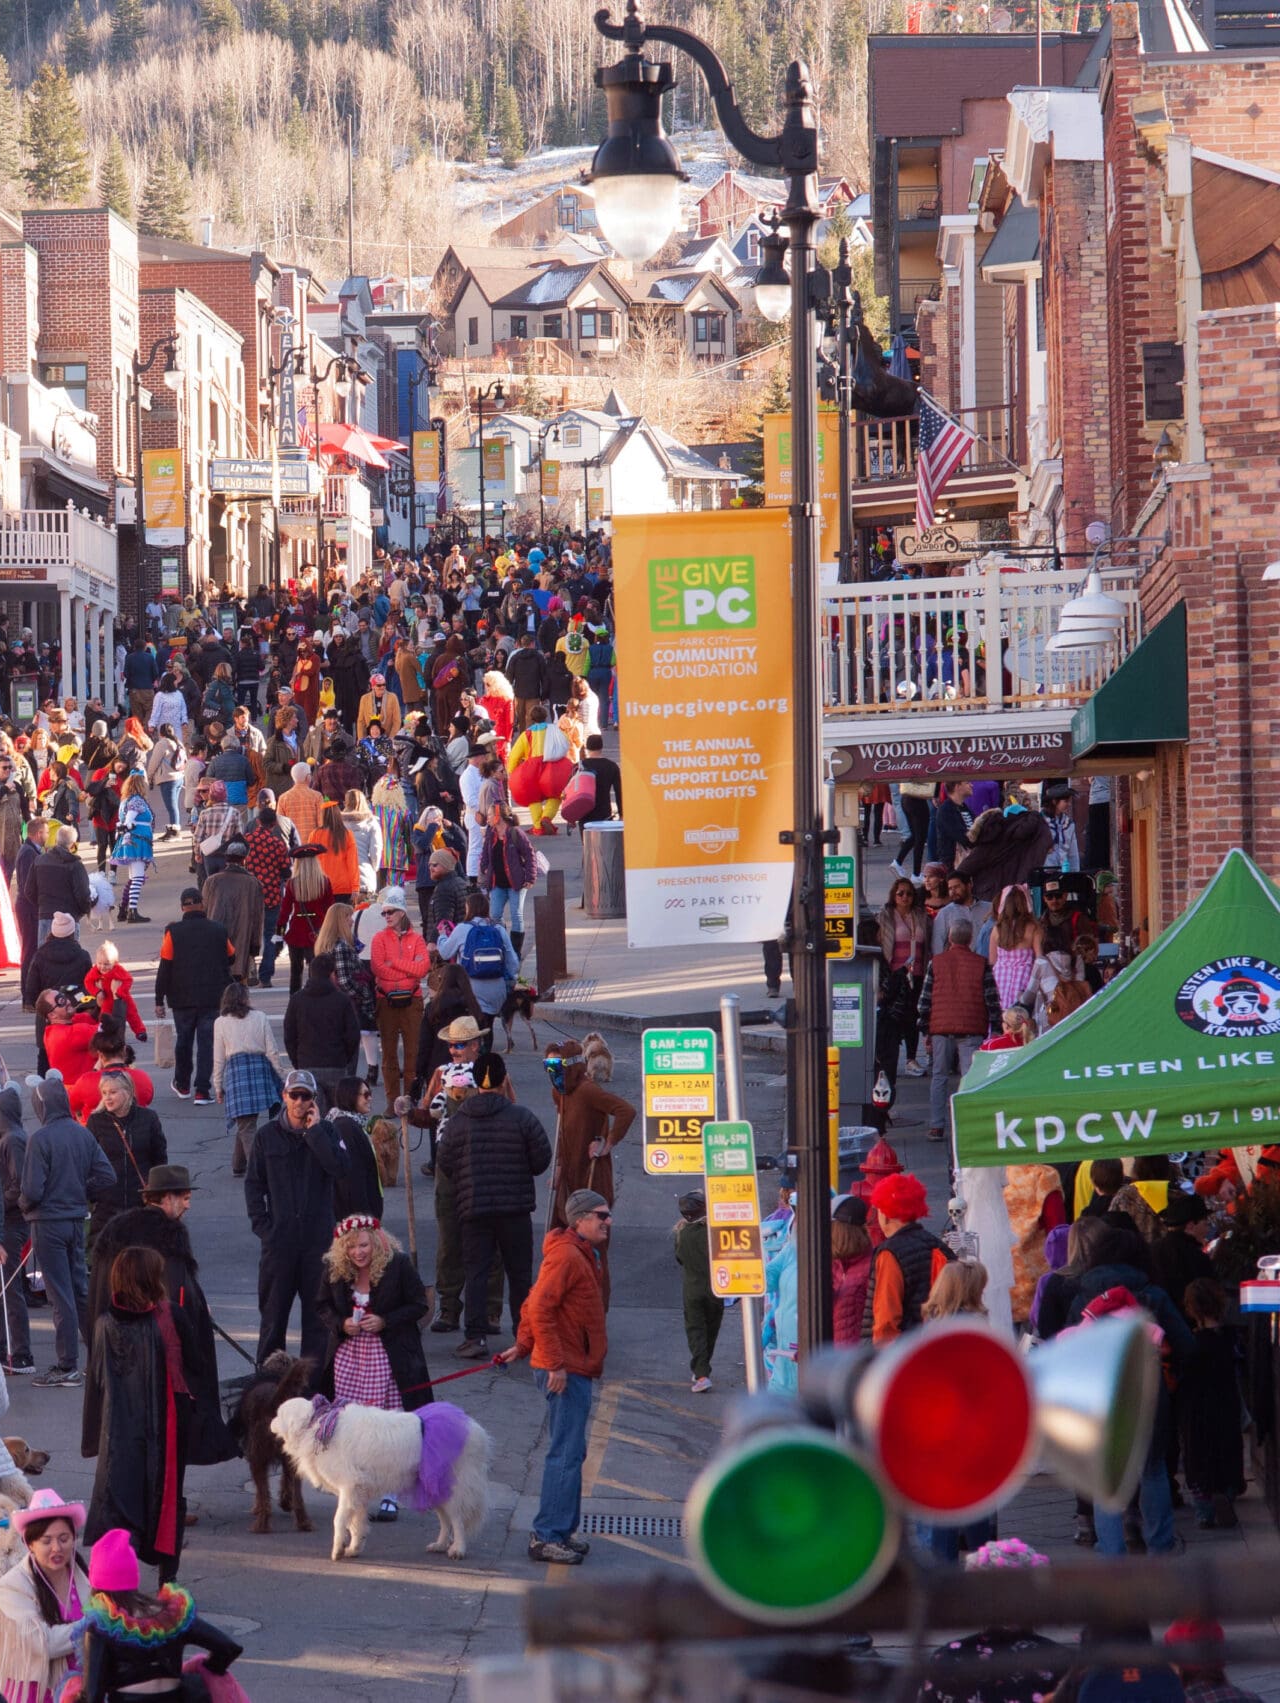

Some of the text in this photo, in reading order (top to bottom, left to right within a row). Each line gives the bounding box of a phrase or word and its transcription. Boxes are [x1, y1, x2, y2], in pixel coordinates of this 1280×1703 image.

[681, 561, 749, 586] GIVE
[655, 563, 680, 627] LIVE
[683, 586, 751, 625] PC
[680, 635, 732, 646] PARK CITY
[652, 646, 758, 664] COMMUNITY
[652, 662, 758, 680] FOUNDATION
[625, 697, 789, 718] livepcgivepc.org
[663, 737, 755, 753] THE ANNUAL
[859, 732, 1063, 760] WOODBURY JEWELERS
[657, 752, 761, 769] GIVING DAY TO
[873, 752, 1045, 774] Custom Jewelry Designs
[650, 769, 768, 786] SUPPORT LOCAL
[663, 785, 757, 801] NONPROFITS
[657, 873, 768, 888] PRESENTING SPONSOR
[691, 895, 763, 908] PARK CITY
[1178, 965, 1216, 1000] LISTEN
[1216, 956, 1251, 970] LIKE
[1254, 960, 1266, 971] A
[650, 1039, 675, 1049] 8AM
[683, 1039, 708, 1049] 5PM
[655, 1054, 671, 1068] 15
[1063, 1051, 1275, 1080] LISTEN LIKE
[655, 1103, 705, 1111] BY PERMIT ONLY
[659, 1118, 701, 1137] DLS
[995, 1108, 1158, 1153] kpcw
[1182, 1111, 1220, 1129] 91.7
[712, 1153, 724, 1168] 15
[720, 1229, 751, 1251] DLS
